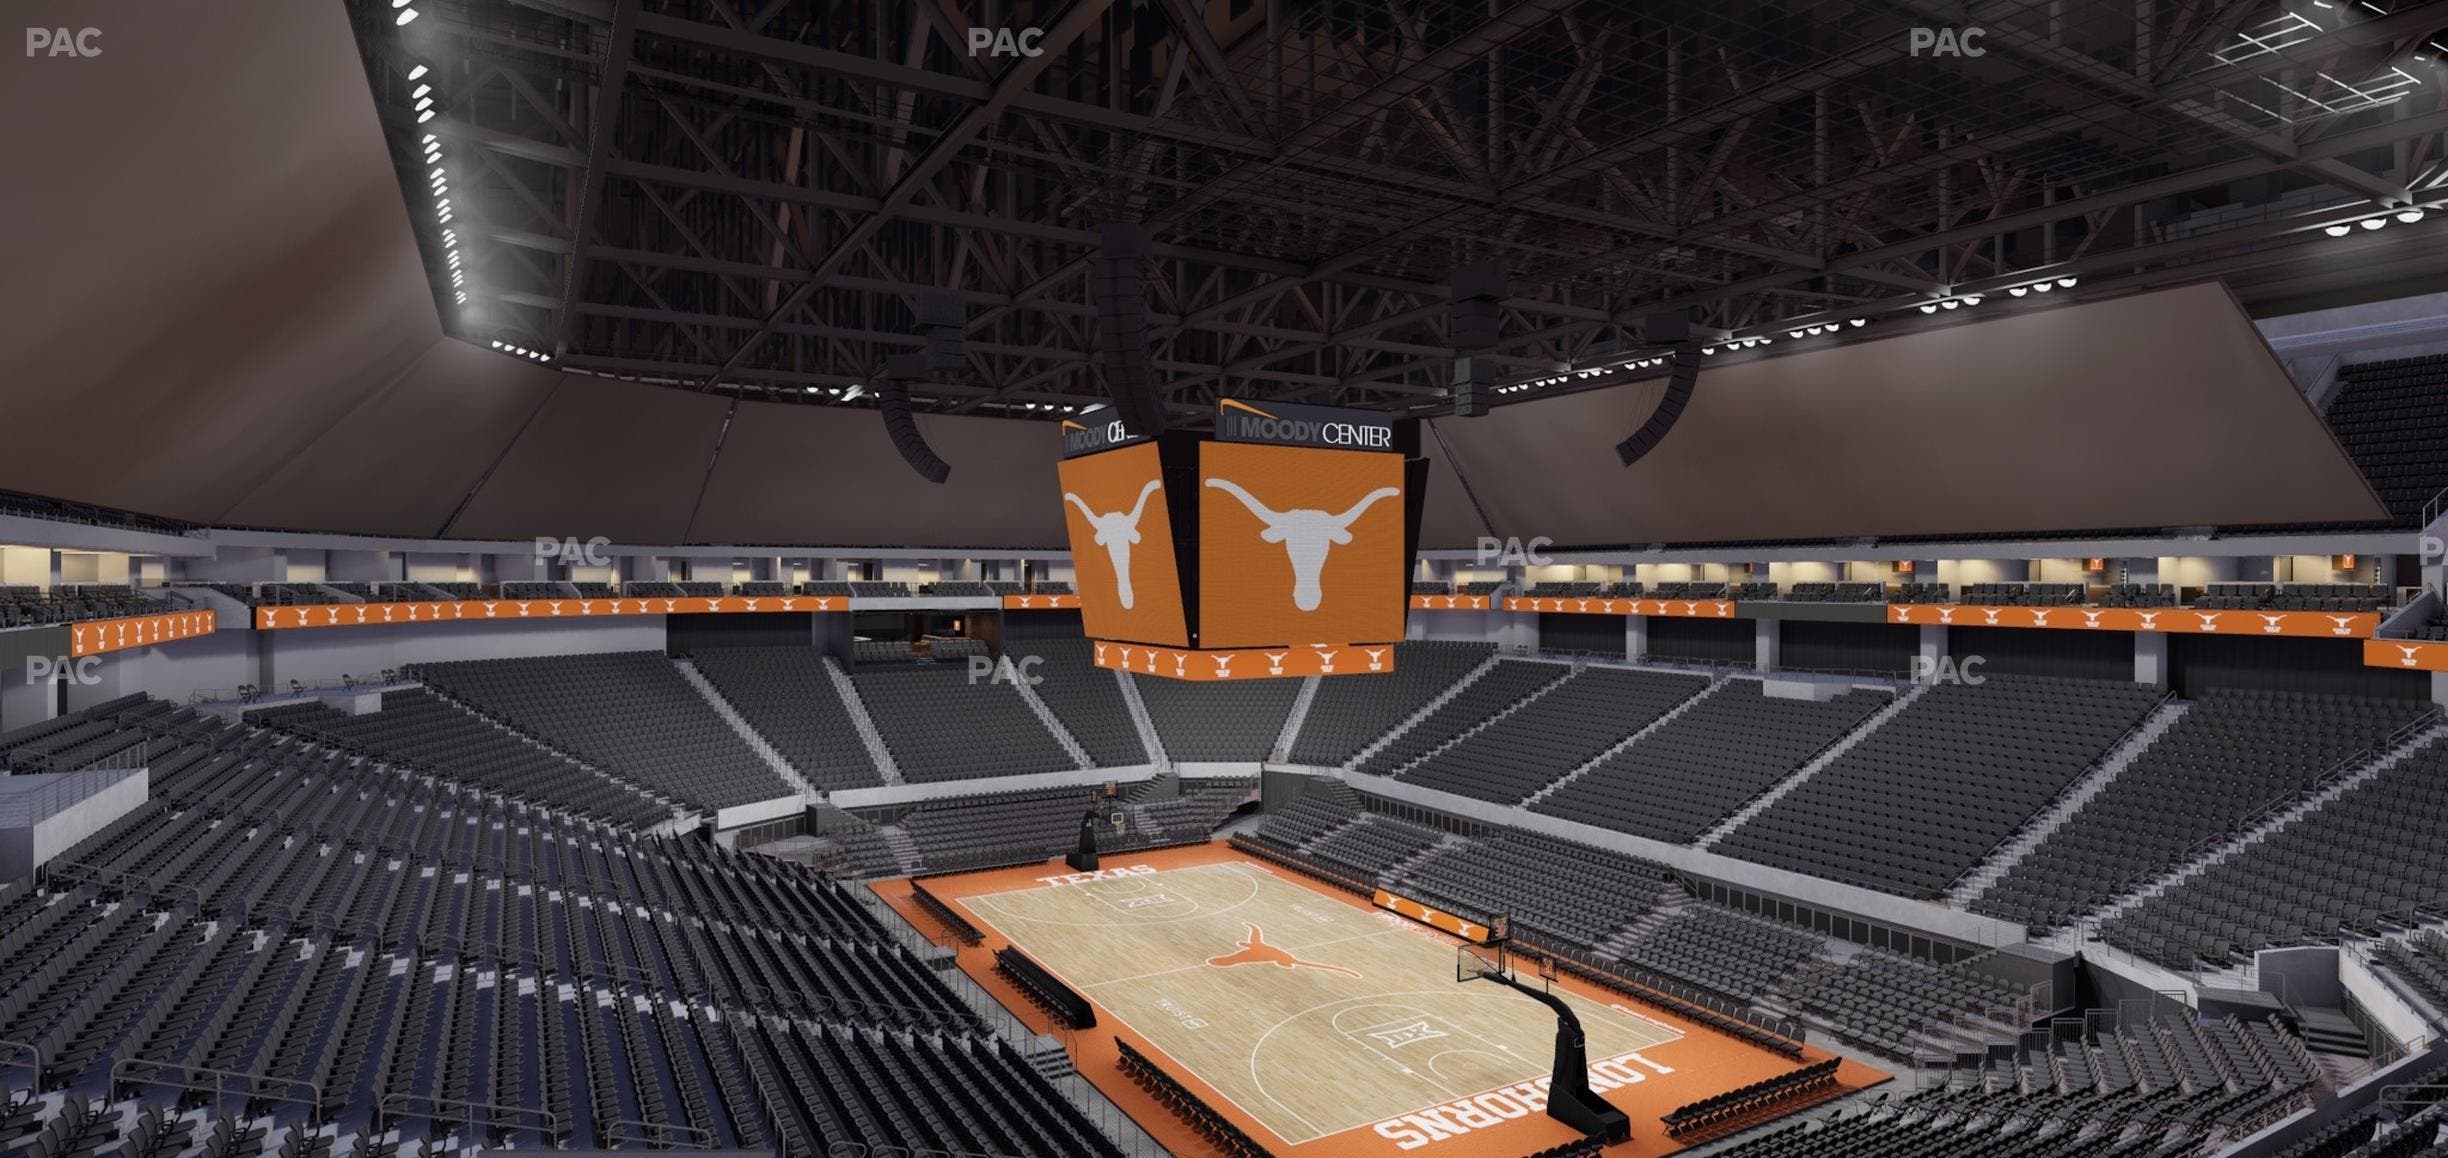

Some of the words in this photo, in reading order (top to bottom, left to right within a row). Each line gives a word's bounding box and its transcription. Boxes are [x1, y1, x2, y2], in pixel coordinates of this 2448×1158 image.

[1070, 424, 1107, 452] MOODY
[1240, 416, 1320, 442] MOODY
[1322, 422, 1391, 448] CENTER
[1035, 864, 1157, 888] TEXAS
[1373, 1052, 1675, 1150] LONHORNS
